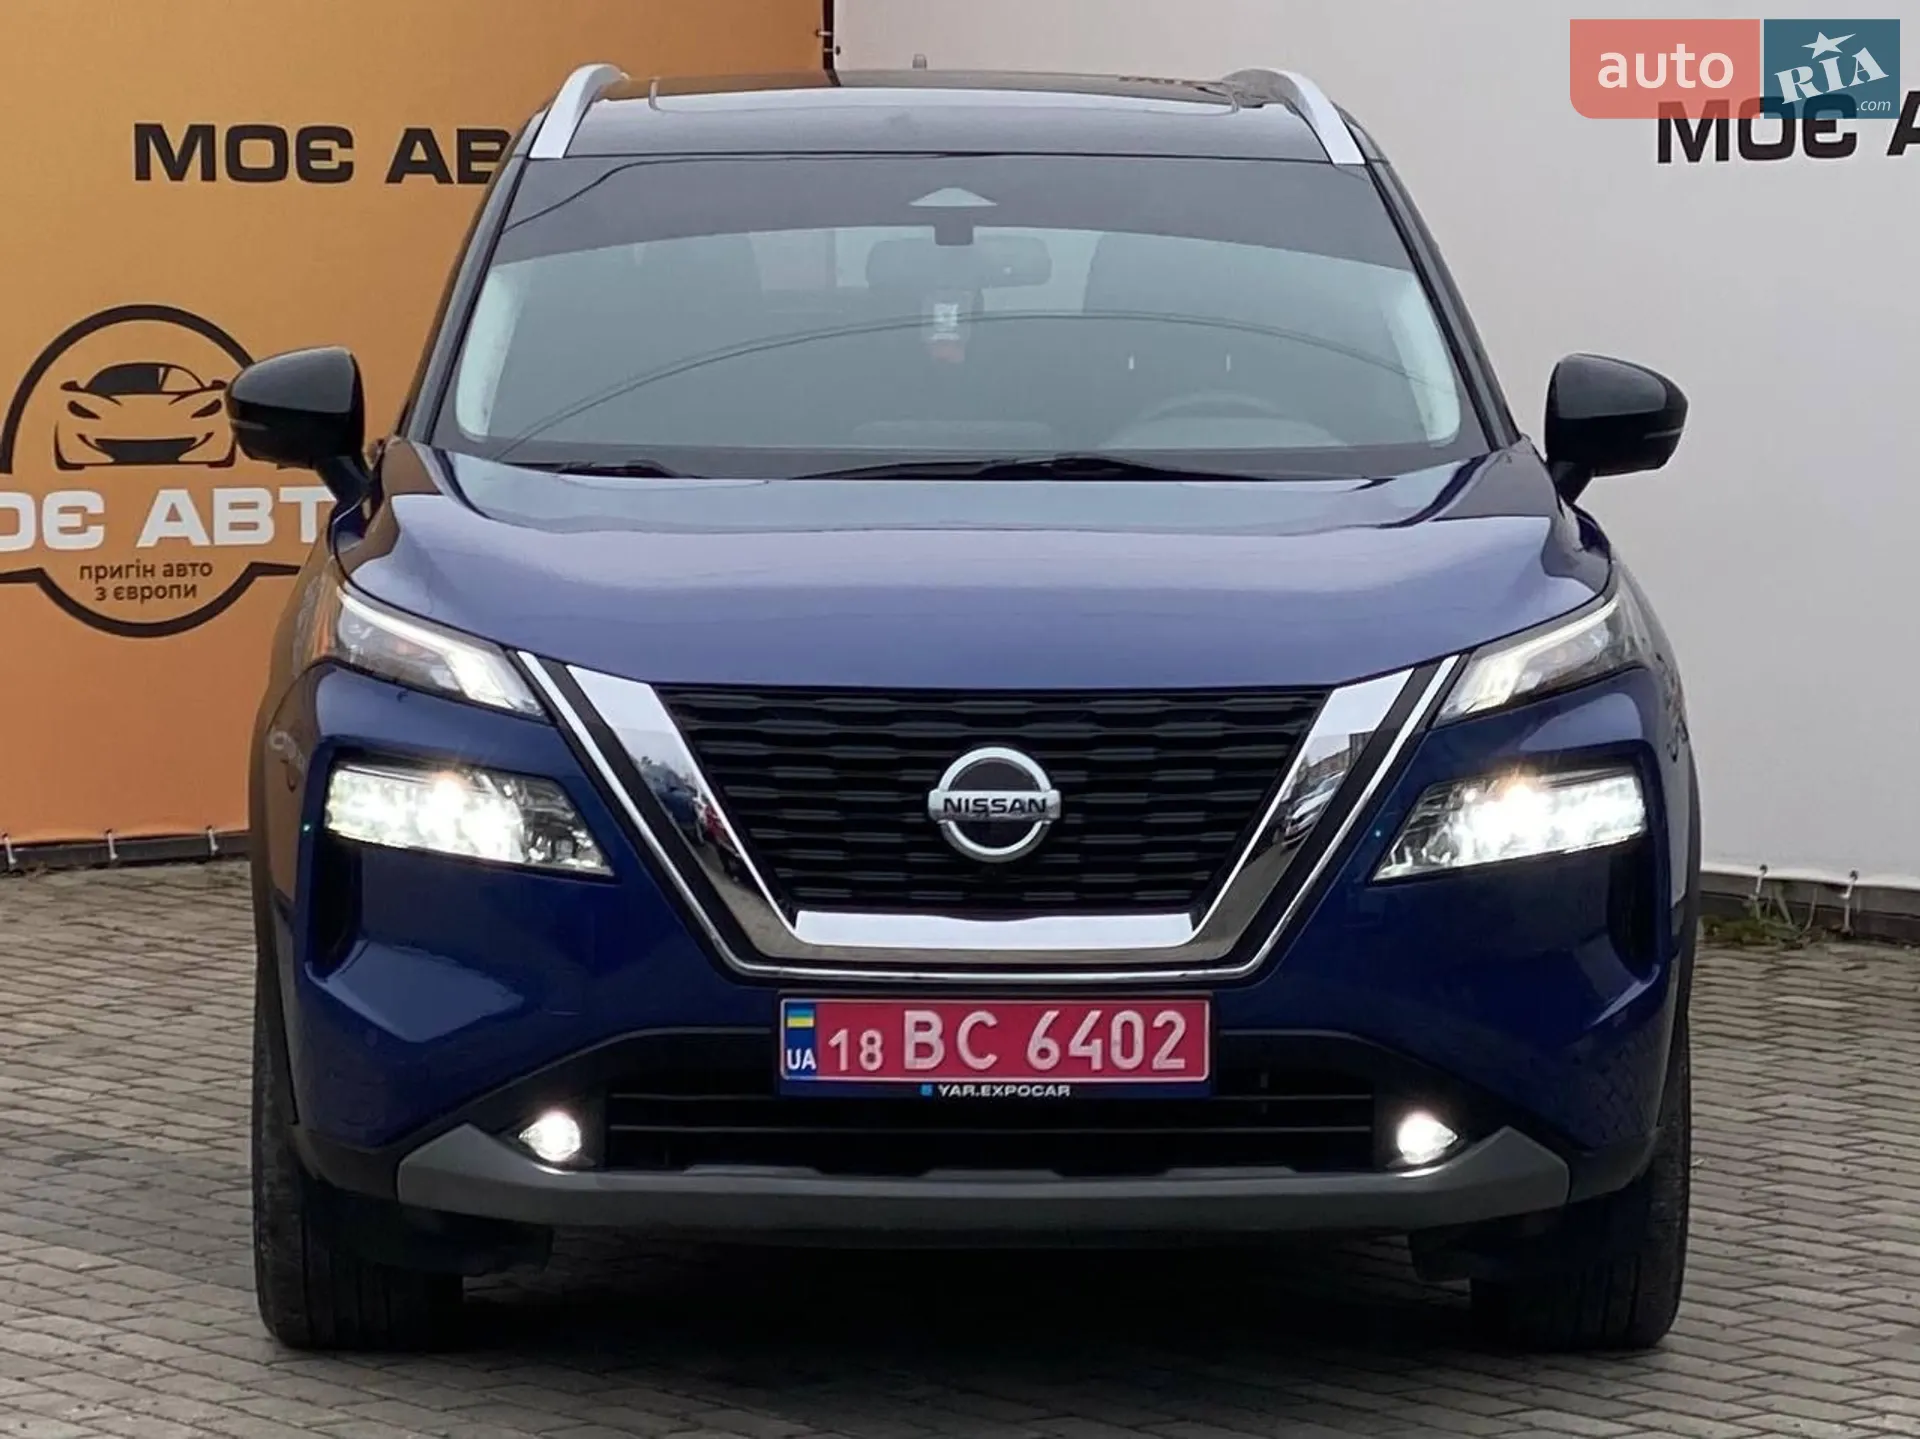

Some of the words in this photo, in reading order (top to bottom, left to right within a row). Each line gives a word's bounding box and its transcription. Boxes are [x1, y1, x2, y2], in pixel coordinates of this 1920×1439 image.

[134, 122, 354, 184] МОЄ
[80, 558, 155, 583] пригін
[162, 561, 213, 578] авто
[112, 583, 197, 604] європи
[943, 797, 1047, 814] NISSAN
[828, 1028, 884, 1072] 18
[904, 1009, 998, 1071] BC
[1026, 1009, 1187, 1071] 6402
[787, 1047, 817, 1071] UA
[938, 1084, 1071, 1098] YAR.EXPOCAR
